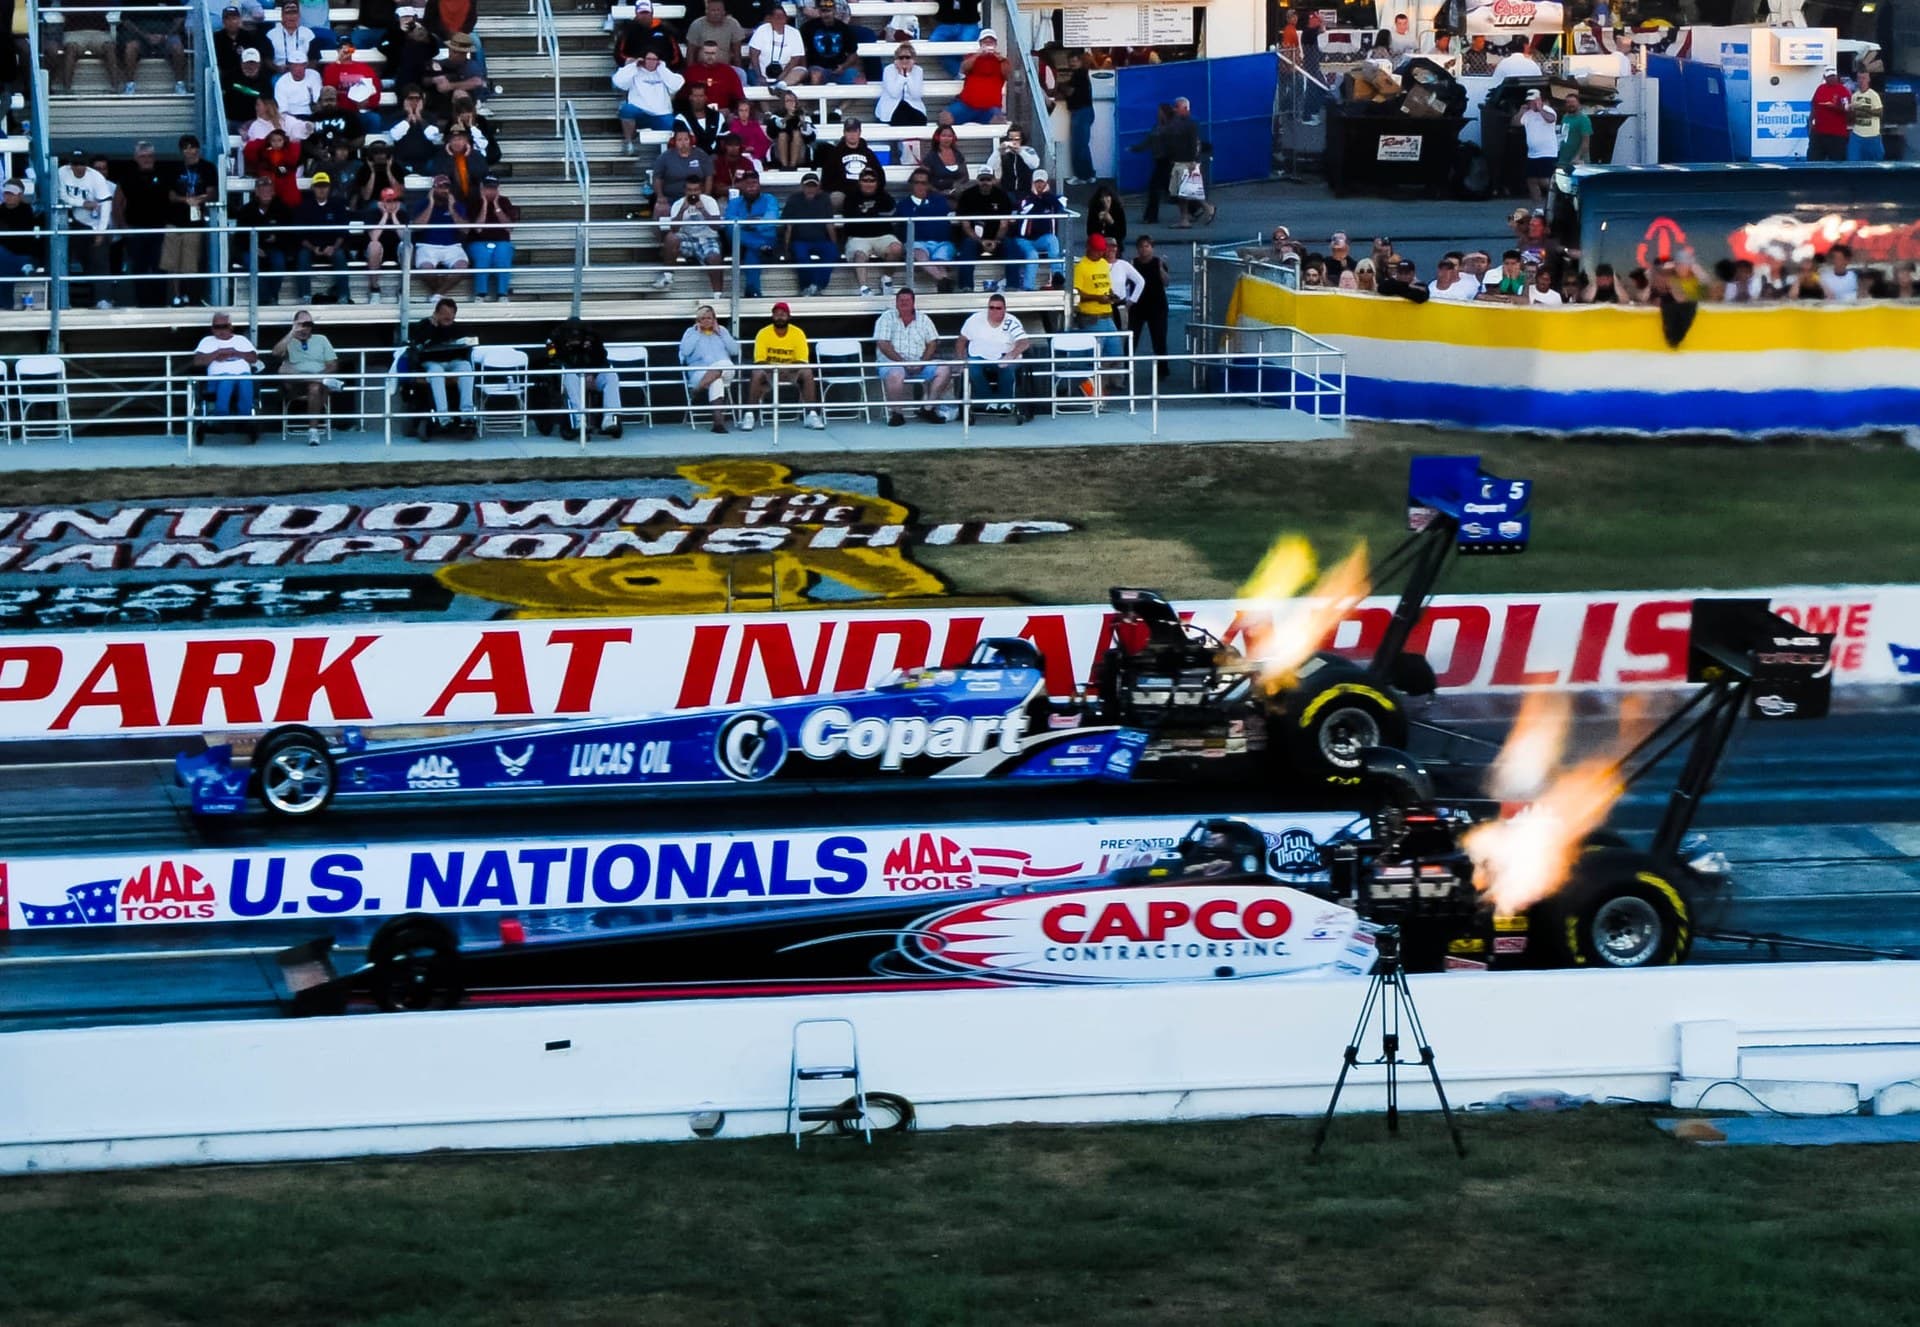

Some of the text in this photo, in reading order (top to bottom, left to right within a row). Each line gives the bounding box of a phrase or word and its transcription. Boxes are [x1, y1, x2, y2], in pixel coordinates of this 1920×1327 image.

[1495, 15, 1532, 25] LIGHT
[1757, 113, 1789, 125] Home
[1508, 481, 1525, 499] 5
[750, 493, 830, 508] TO
[741, 506, 854, 523] THE
[0, 636, 382, 730] PARK
[423, 628, 632, 717] AT
[800, 706, 1030, 771] Copart
[407, 755, 460, 778] MAC
[569, 741, 671, 776] LUCAS OIL
[408, 778, 460, 788] TOOLS
[883, 832, 972, 877] MAC
[1100, 838, 1175, 852] PRESENTED
[121, 860, 215, 905] MAC
[229, 836, 868, 917] U.S. NATIONALS
[884, 874, 973, 891] TOOLS
[121, 903, 217, 920] TOOLS
[1041, 899, 1293, 944] CAPCO
[1044, 942, 1234, 962] CONTRACTORS
